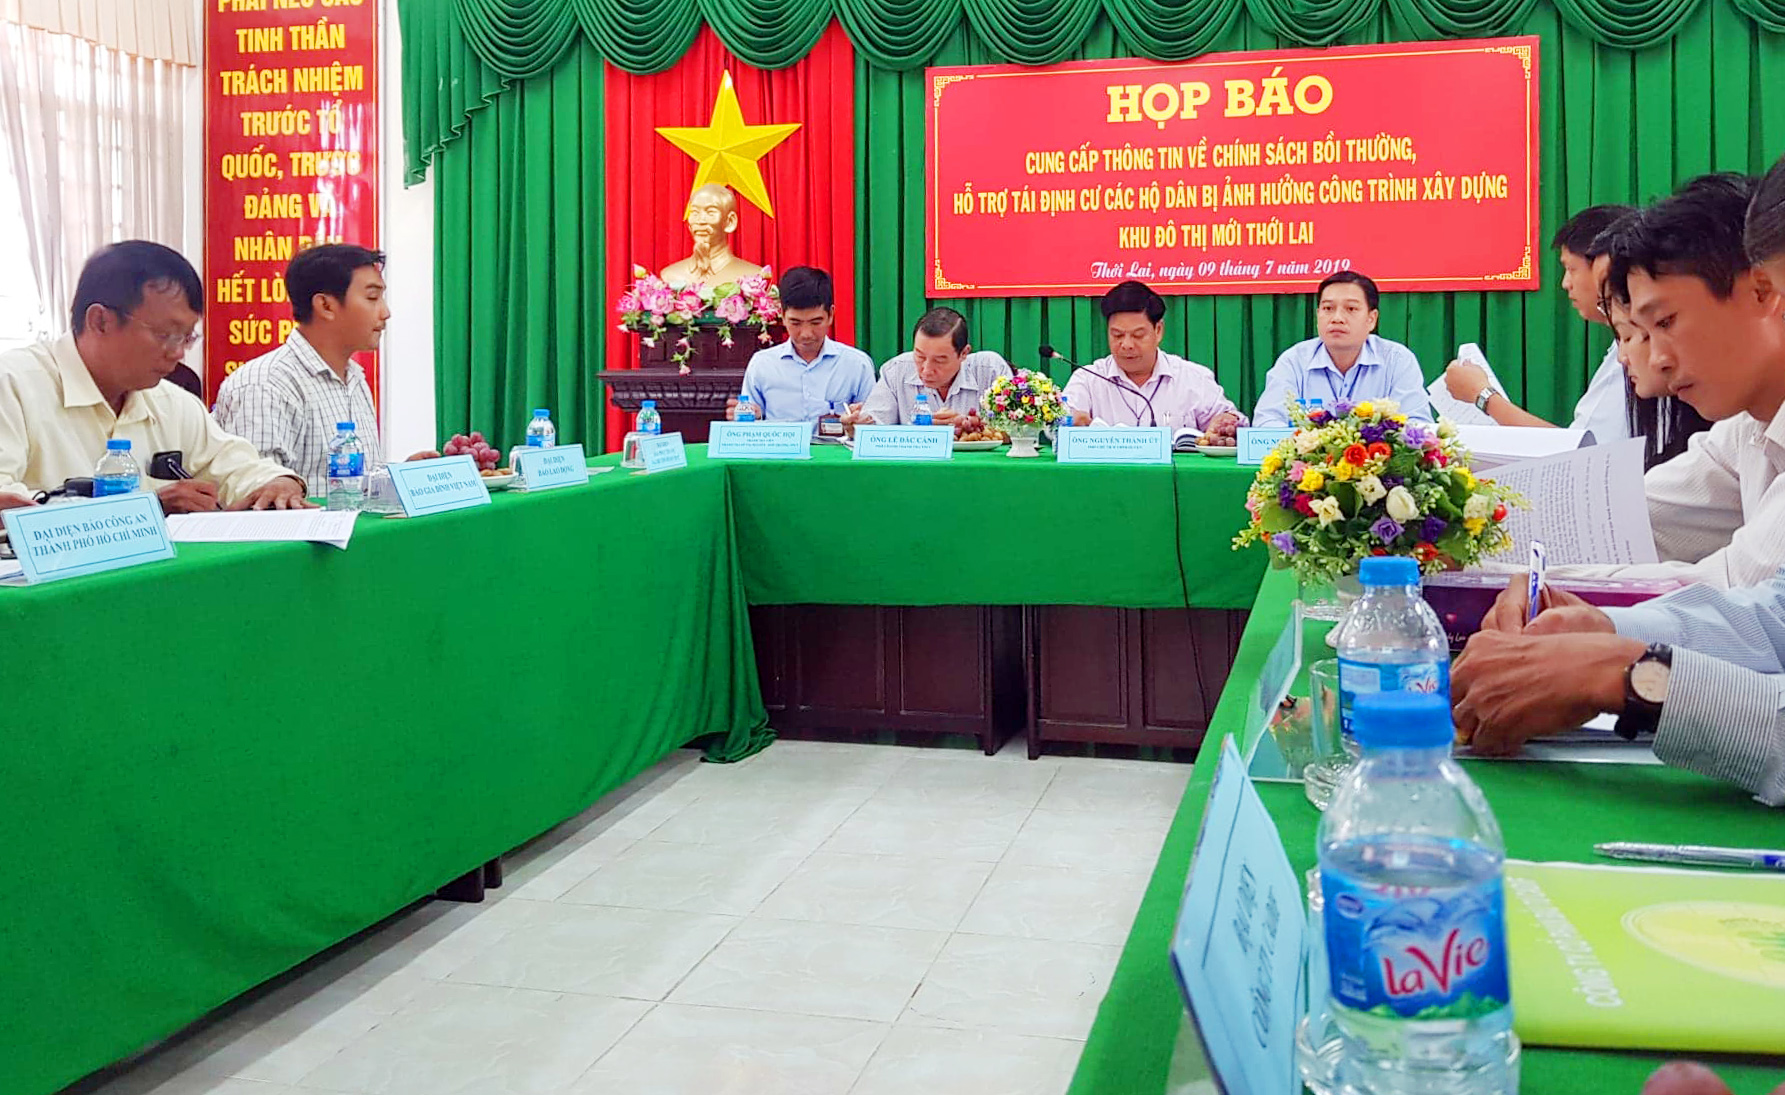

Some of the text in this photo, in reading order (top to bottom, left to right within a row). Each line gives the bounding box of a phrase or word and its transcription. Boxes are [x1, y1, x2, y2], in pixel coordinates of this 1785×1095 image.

[235, 16, 345, 53] TINH THẦN
[220, 61, 363, 96] TRÁCH NHIỆM
[1106, 67, 1333, 129] HỌP BÁO
[240, 99, 343, 136] TRƯỚC TỔ
[221, 144, 284, 181] QUỐC,
[1025, 130, 1416, 174] CUNG CẤP THÔNG TIN VỀ CHÍNH SÁCH BỒI THƯỜNG,
[244, 187, 303, 219] ĐẢNG
[953, 171, 1508, 217] HỖ TRỢ TÁI ĐỊNH CƯ CÁC HỘ DÂN BỊ ẢNH HƯỞNG CÔNG TRÌNH XÂY DỰNG
[234, 230, 292, 261] NHÂN
[1119, 216, 1314, 251] KHU ĐÔ THỊ MỚI THỚI LAI
[217, 270, 255, 303] HẾT
[1091, 258, 1350, 280] Thới Lai, ngày 09 tháng 7 năm 2019
[229, 314, 272, 344] SỨC
[34, 513, 148, 543] ĐẠI DIỆN BÁO CÔNG AN
[113, 528, 130, 542] CHÍ
[132, 525, 158, 539] MINH
